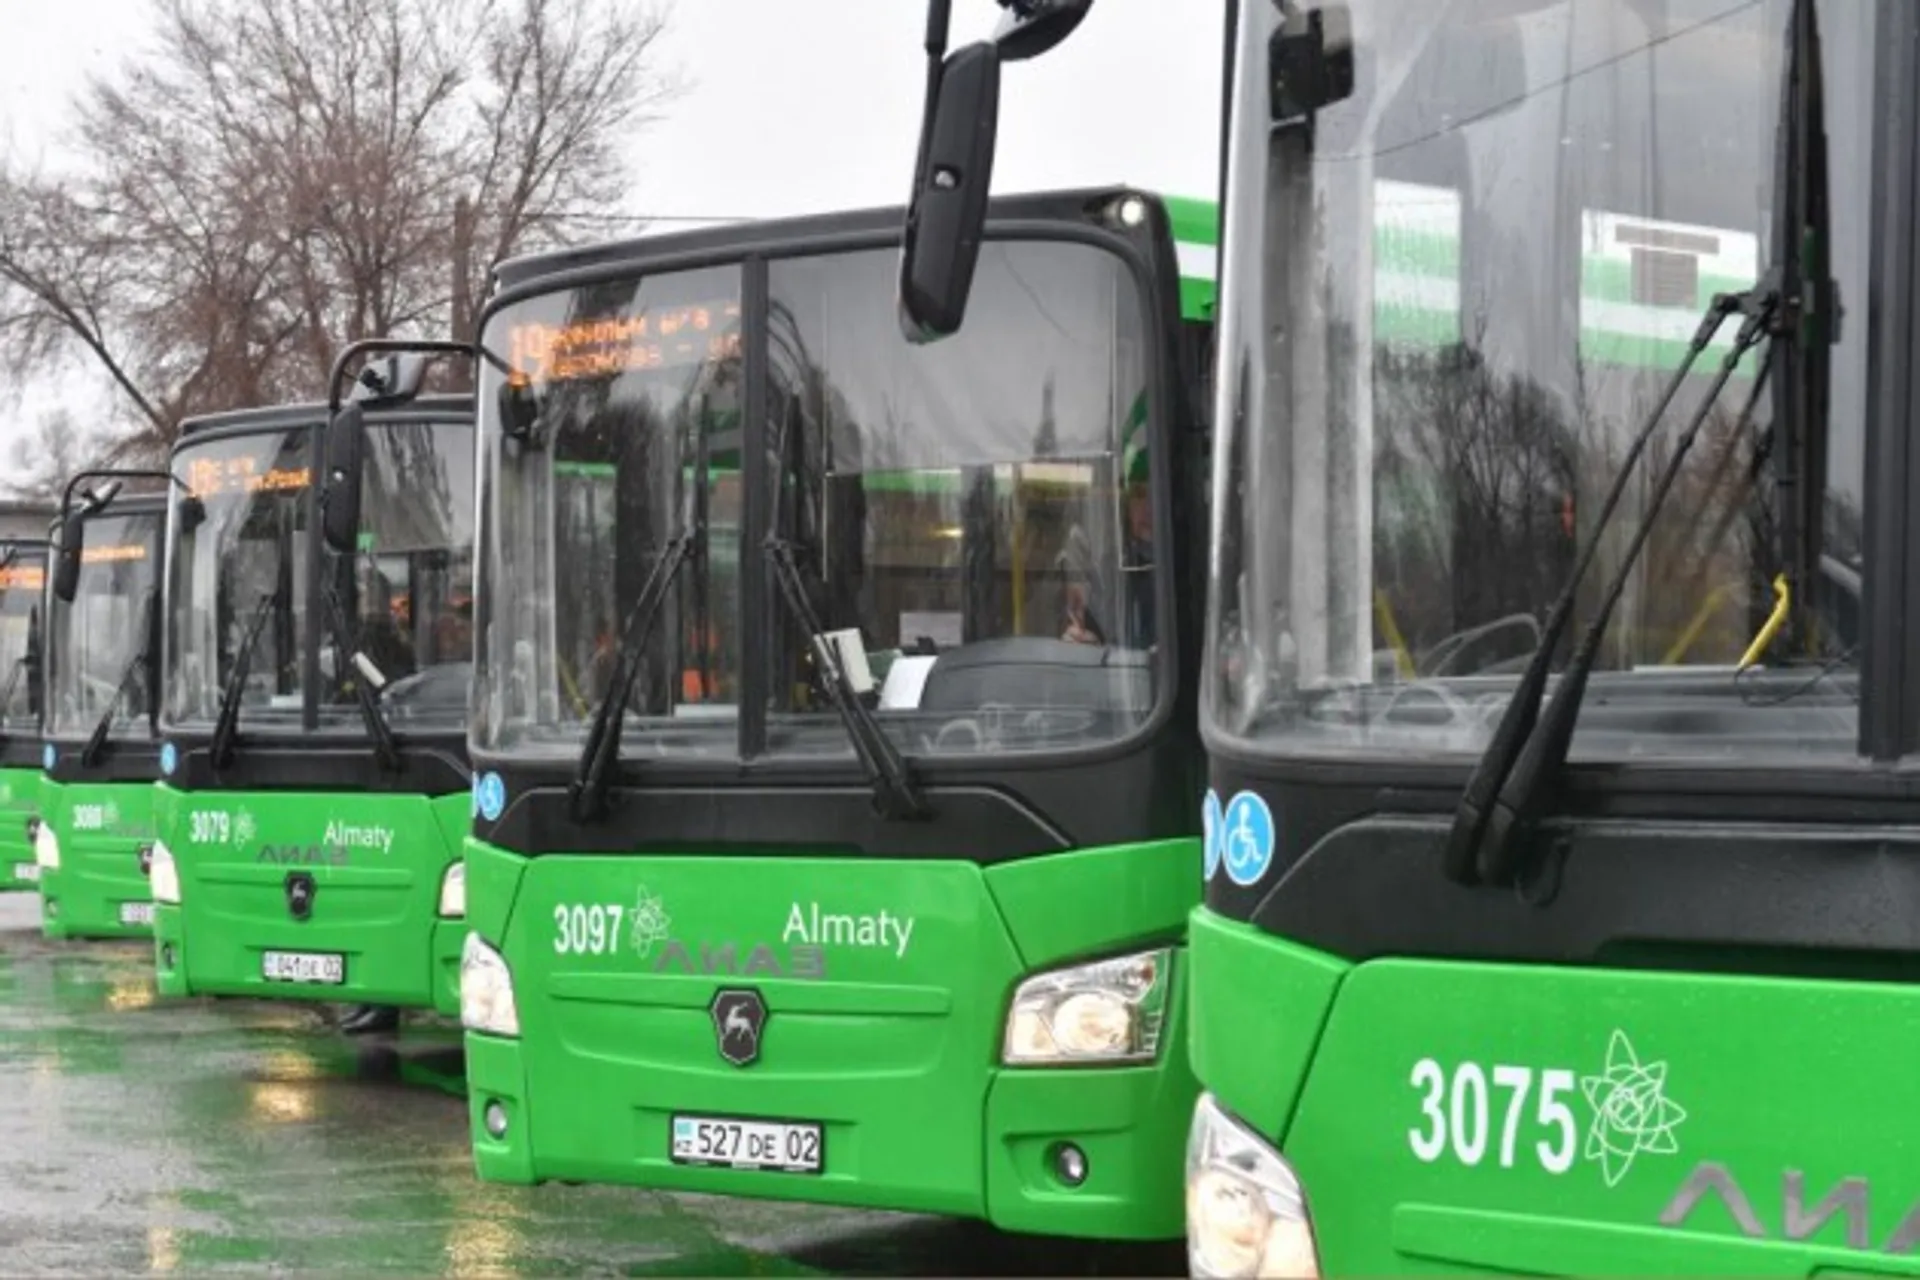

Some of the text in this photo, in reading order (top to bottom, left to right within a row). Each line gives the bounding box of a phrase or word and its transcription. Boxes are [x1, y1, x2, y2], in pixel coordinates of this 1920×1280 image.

[189, 810, 230, 844] 3079
[322, 819, 394, 854] Almaty
[553, 903, 623, 955] 3097
[782, 901, 915, 959] Almaty
[1408, 1057, 1577, 1174] 3075
[698, 1123, 742, 1156] 527
[748, 1133, 776, 1160] DE
[785, 1130, 818, 1162] 02
